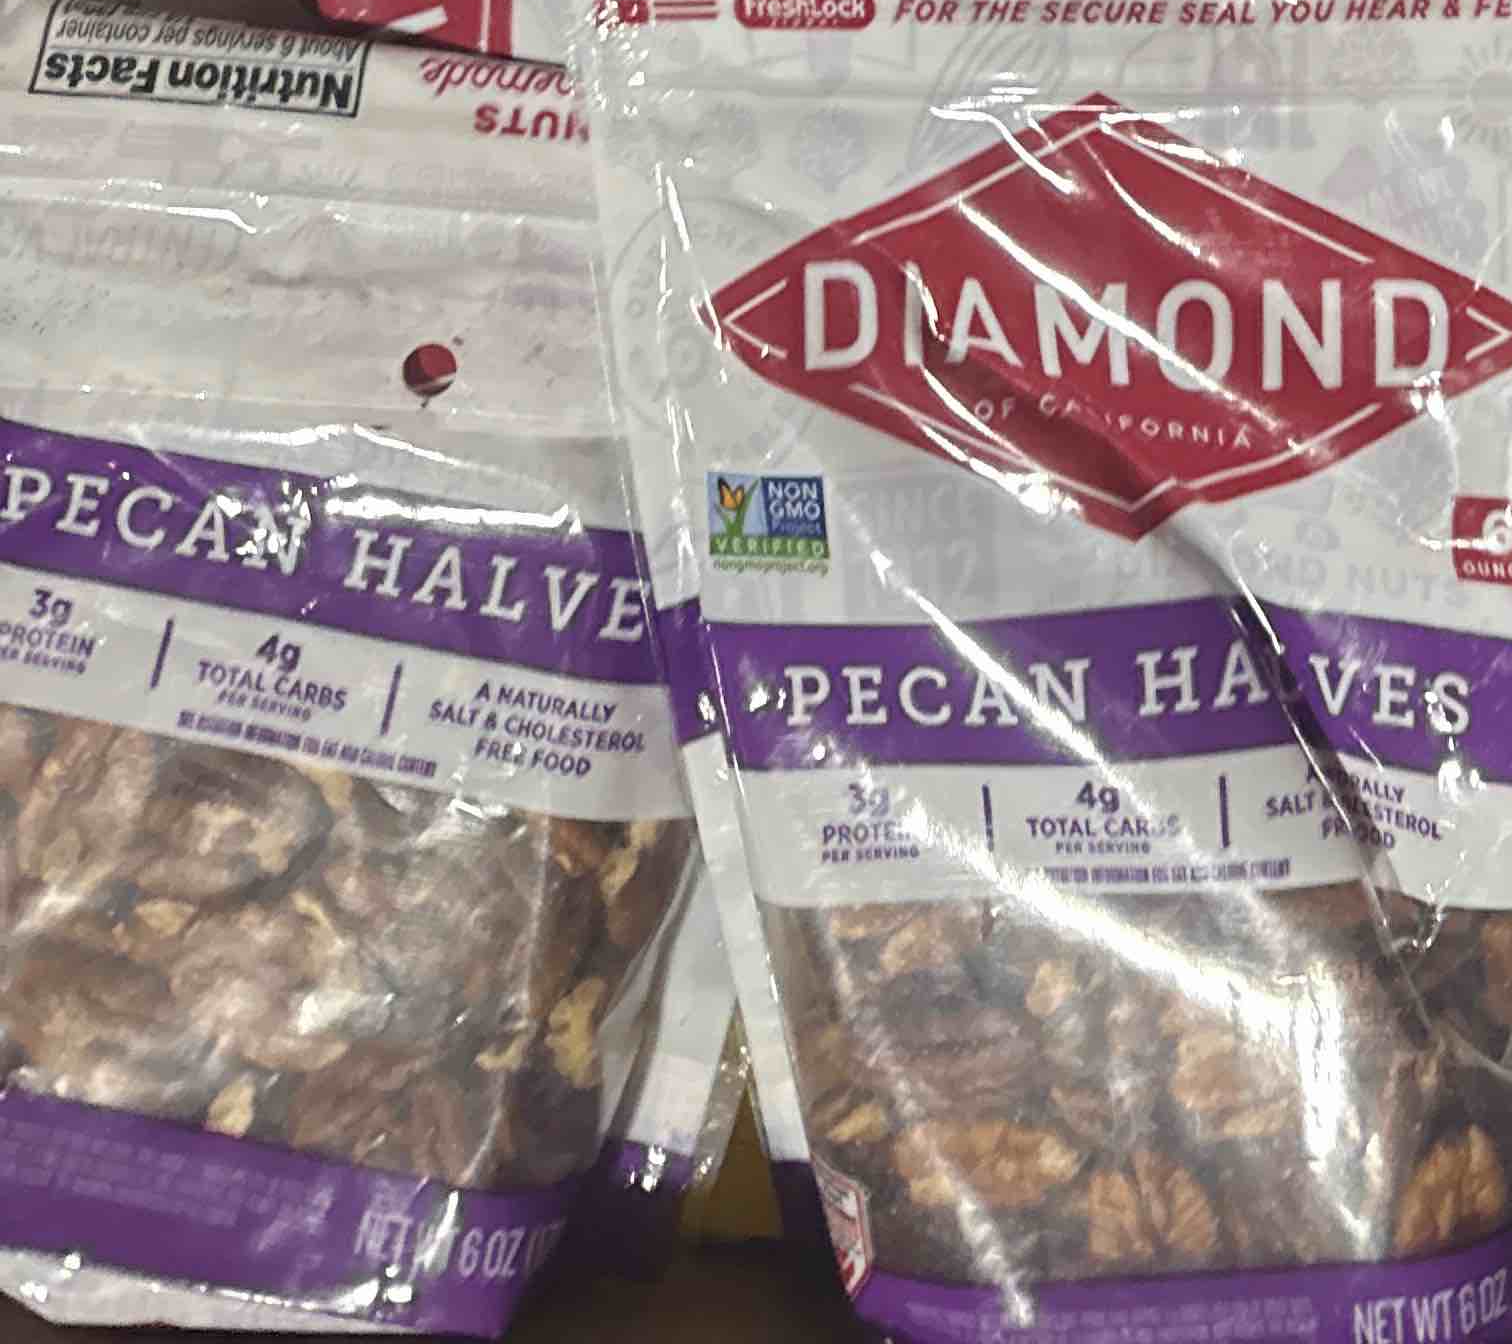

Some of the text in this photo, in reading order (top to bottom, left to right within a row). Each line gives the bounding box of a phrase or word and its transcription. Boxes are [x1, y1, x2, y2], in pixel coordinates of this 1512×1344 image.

[895, 0, 959, 25] FOR
[1040, 0, 1164, 26] SECURE
[57, 16, 358, 61] About 6 servings per container
[43, 53, 352, 109] Nutrition Facts
[802, 260, 1449, 393] DIAMOND
[768, 481, 817, 500] NON
[769, 499, 821, 521] GMO
[3, 466, 651, 643] PECAN HALVE
[715, 537, 825, 558] VERIFIED
[28, 589, 73, 626] 3g
[254, 634, 302, 671] 4g
[200, 661, 348, 712] TOTAL CARBS
[476, 681, 618, 725] A NATURALLY
[783, 640, 1471, 736] PECAN HAVES
[848, 782, 889, 816] 3g
[1077, 779, 1121, 814] 4g
[1266, 794, 1314, 818] SALT
[459, 1226, 526, 1279] 6 OZ
[1354, 1295, 1407, 1344] NET
[1411, 1287, 1454, 1343] WT
[1457, 1282, 1477, 1335] 6
[1479, 1266, 1508, 1325] OZ
